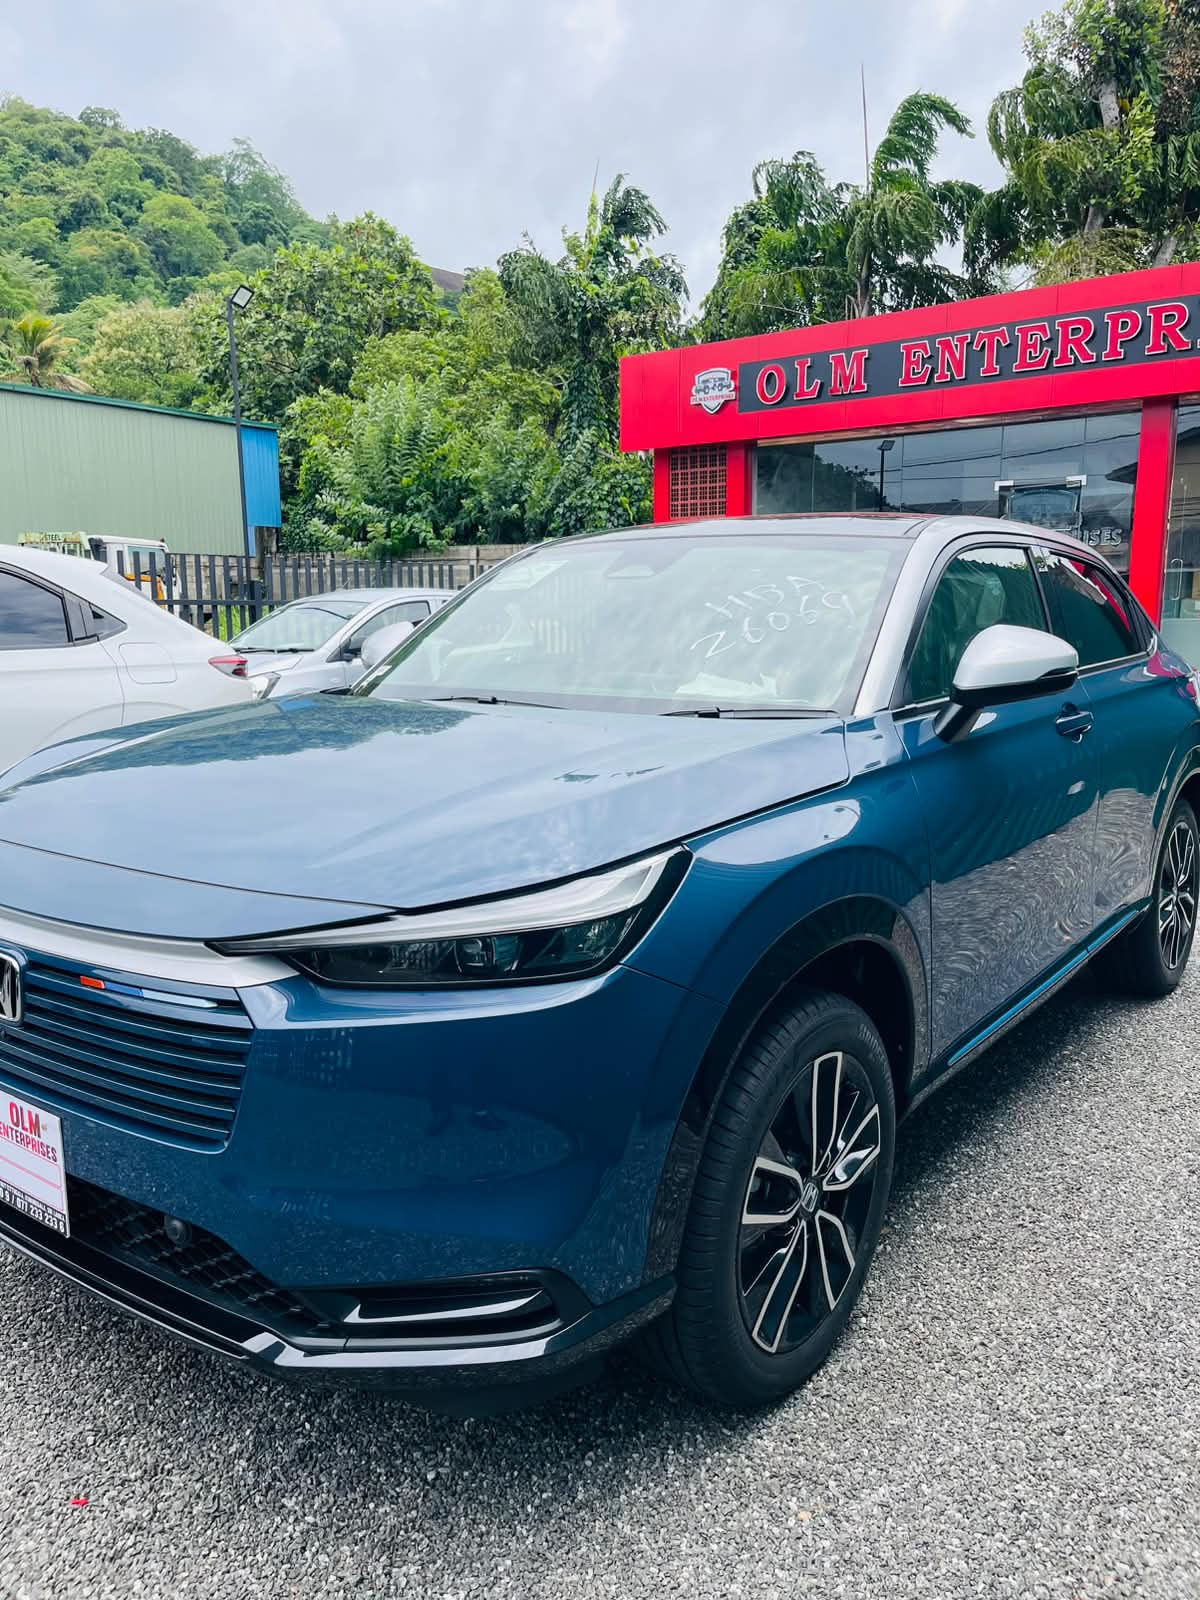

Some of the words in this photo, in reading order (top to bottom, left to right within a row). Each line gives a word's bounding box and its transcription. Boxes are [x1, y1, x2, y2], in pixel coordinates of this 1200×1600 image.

[756, 348, 870, 405] OLM
[898, 301, 1200, 387] ENTERPR
[9, 1101, 41, 1139] OLM
[30, 1205, 43, 1221] 233
[44, 1212, 58, 1230] 233
